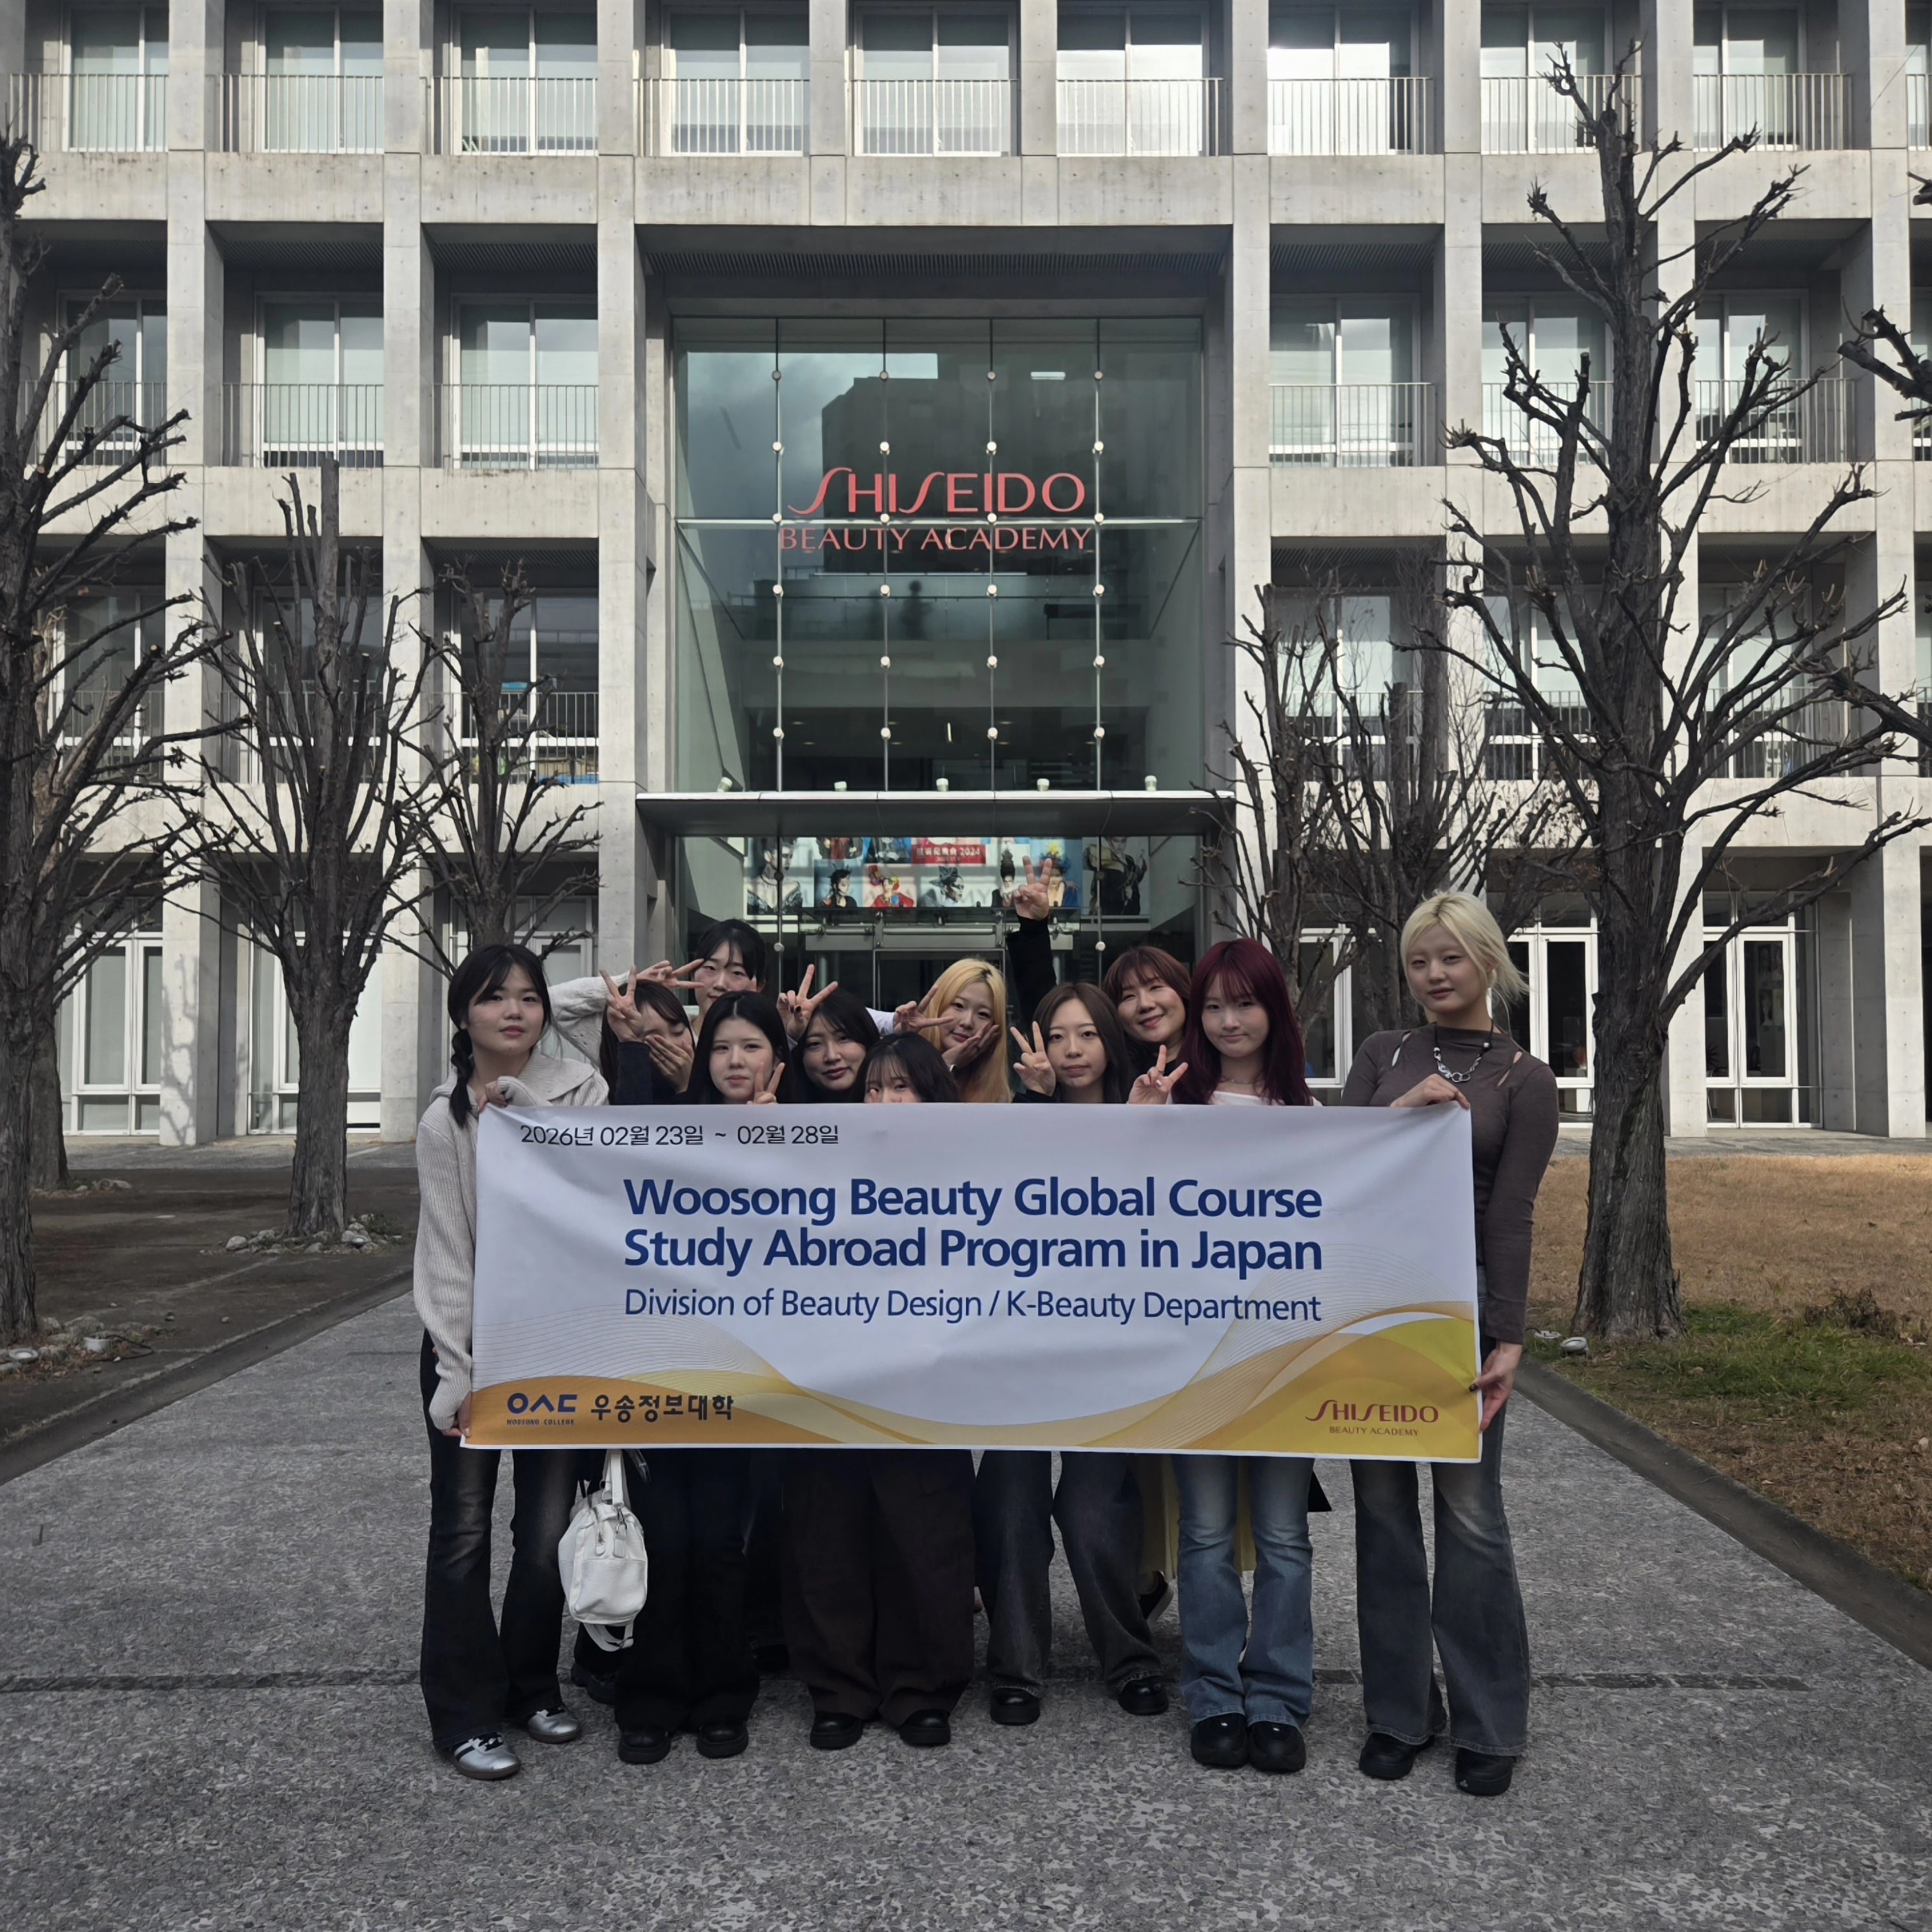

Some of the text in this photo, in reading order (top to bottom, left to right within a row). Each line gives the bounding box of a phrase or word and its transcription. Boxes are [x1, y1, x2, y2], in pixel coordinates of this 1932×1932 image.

[787, 467, 1085, 515] SHISEIDO
[780, 528, 1091, 551] BEAUTY ACADEMY
[520, 1124, 595, 1147] 2026년
[600, 1125, 650, 1147] 02월
[655, 1125, 704, 1146] 23일
[737, 1125, 787, 1146] 02월
[791, 1125, 839, 1145] 28일
[624, 1177, 1322, 1226] Woosong Beauty Global Course
[624, 1227, 1322, 1279] Study Abroad Program in Japan
[626, 1288, 1322, 1326] Division of Beauty Design / K-Beauty Department
[591, 1394, 735, 1423] 우송정보대학
[1305, 1399, 1439, 1423] SHISEIDO
[1329, 1426, 1419, 1437] BEAUTY ACADEMY
